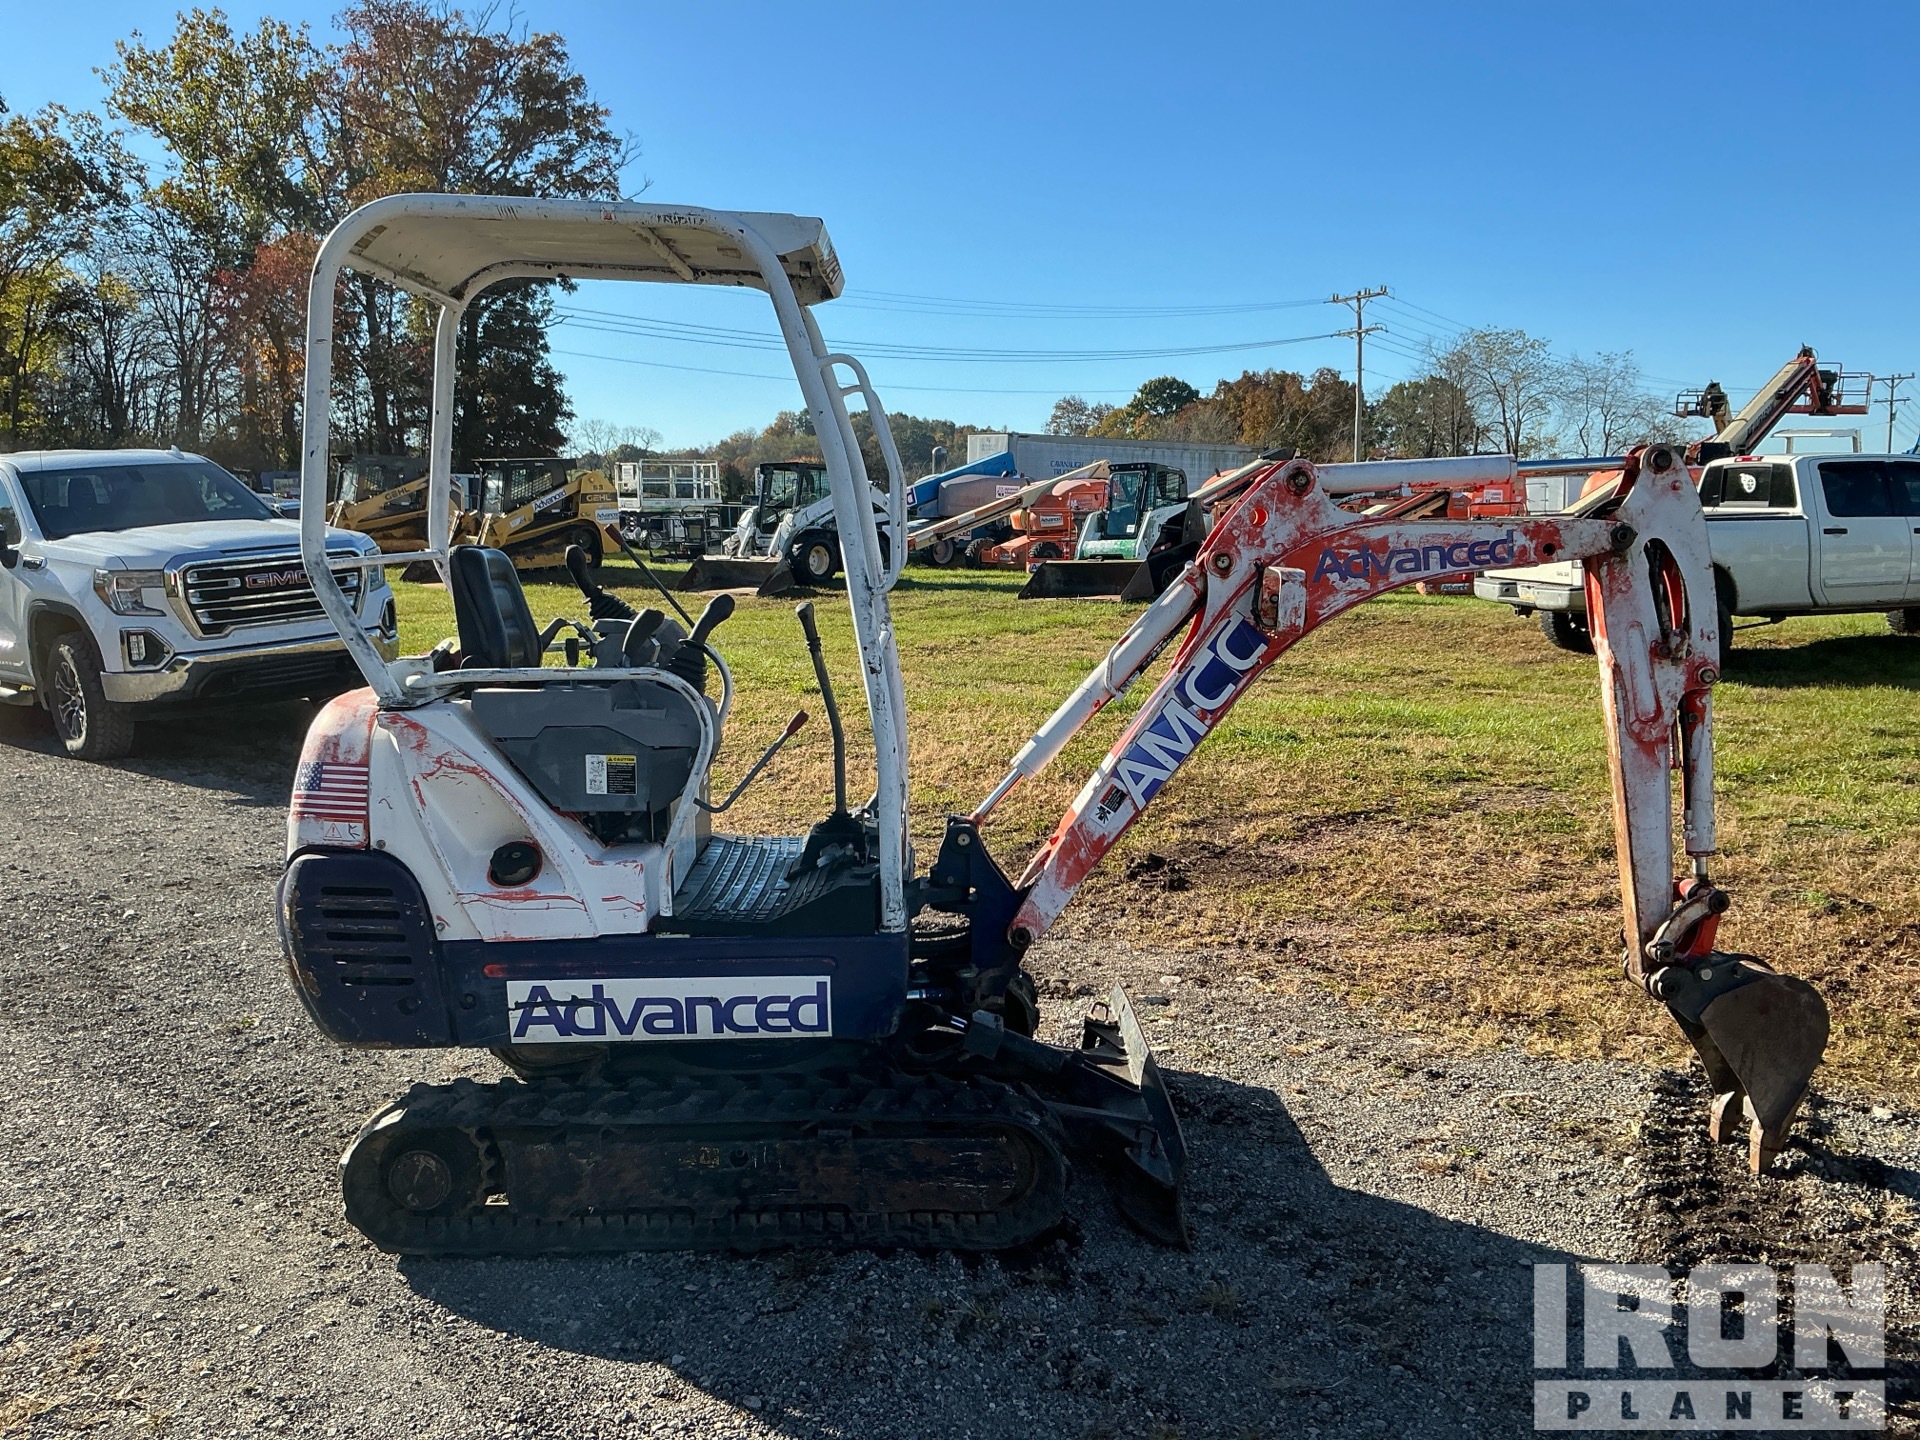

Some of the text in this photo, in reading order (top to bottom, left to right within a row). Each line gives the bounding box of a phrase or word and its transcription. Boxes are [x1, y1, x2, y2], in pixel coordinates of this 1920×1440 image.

[384, 487, 410, 500] GEHL
[534, 489, 567, 510] Advanced
[586, 494, 612, 502] GEHL
[1312, 529, 1514, 583] Advanced
[246, 570, 310, 588] GMC
[513, 981, 828, 1037] Advanced
